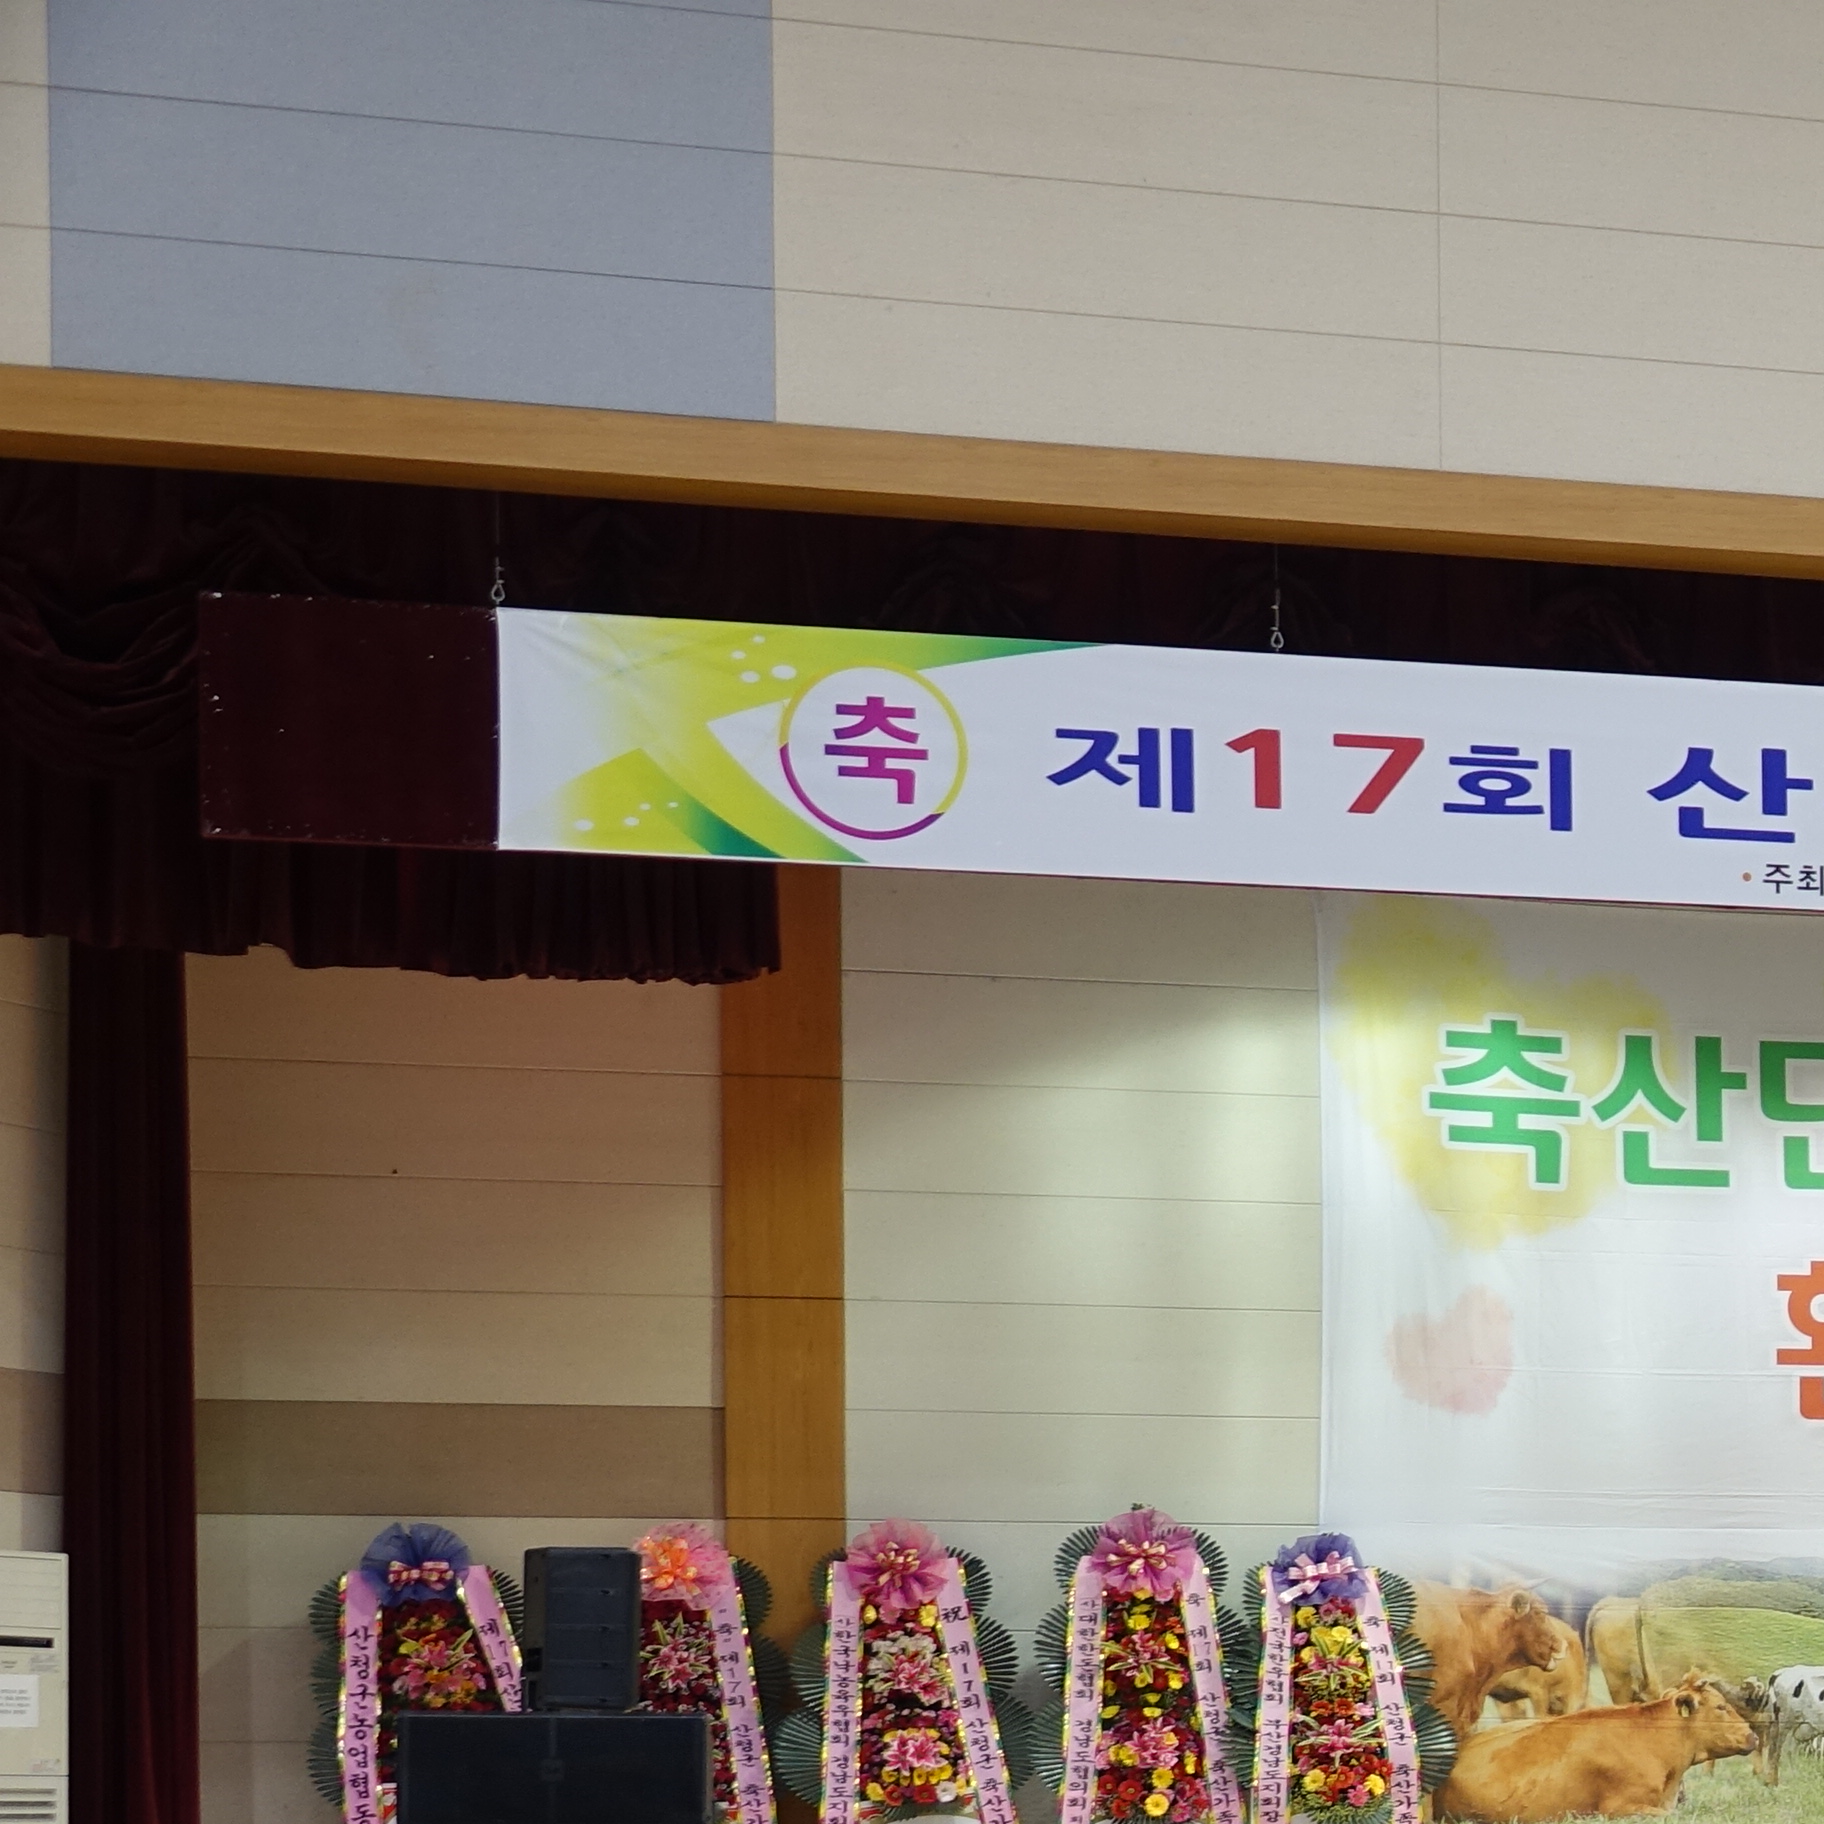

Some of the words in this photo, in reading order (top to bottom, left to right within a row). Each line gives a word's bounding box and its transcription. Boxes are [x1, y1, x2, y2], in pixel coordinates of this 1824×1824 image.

[825, 697, 928, 804] 축
[1046, 726, 1572, 832] 제17회
[1762, 865, 1824, 896] 주최
[951, 1640, 981, 1709] 제17회
[1201, 1692, 1226, 1738] 산청군
[1382, 1702, 1412, 1746] 산청군
[732, 1724, 760, 1767] 산청군
[965, 1720, 998, 1768] 산청군
